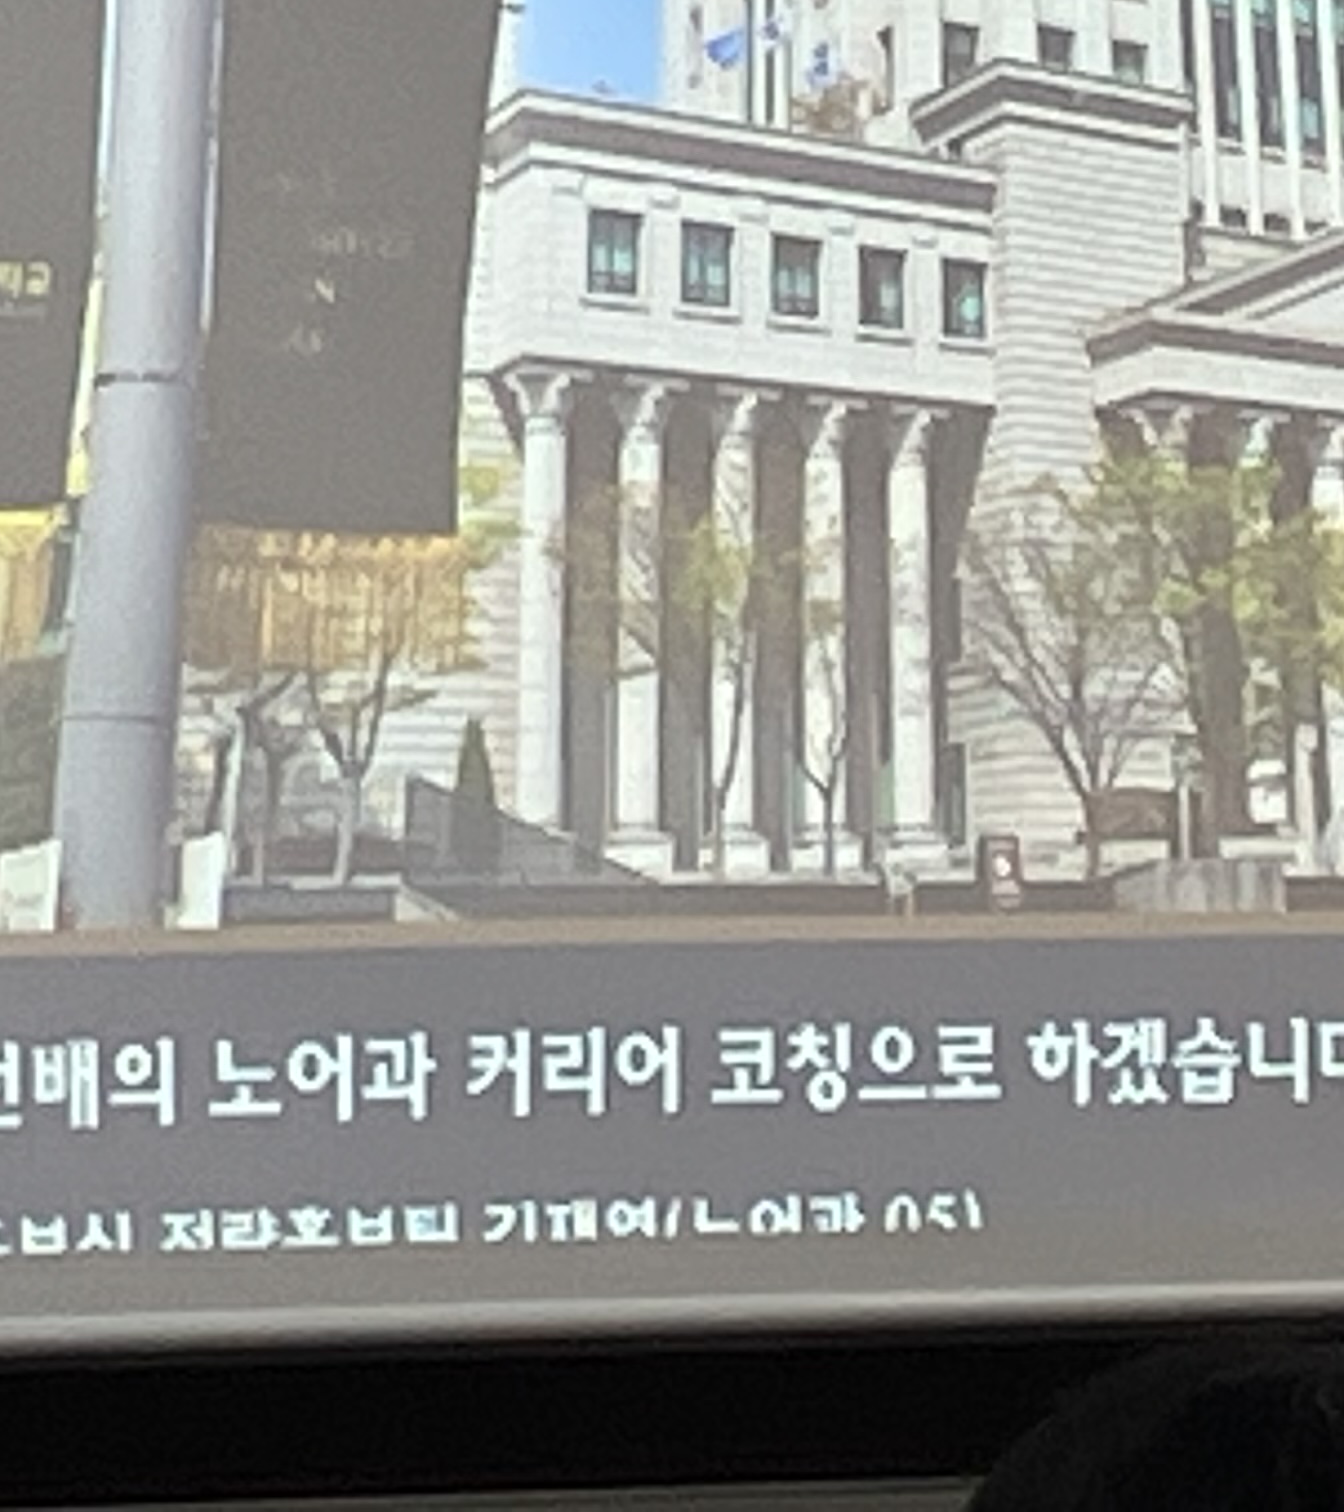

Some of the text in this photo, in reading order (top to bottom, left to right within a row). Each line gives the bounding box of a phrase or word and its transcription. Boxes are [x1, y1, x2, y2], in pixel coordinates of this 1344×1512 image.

[207, 1030, 438, 1124] 노어과
[465, 1024, 680, 1118] 커리어
[710, 1021, 1003, 1113] 코칭으로
